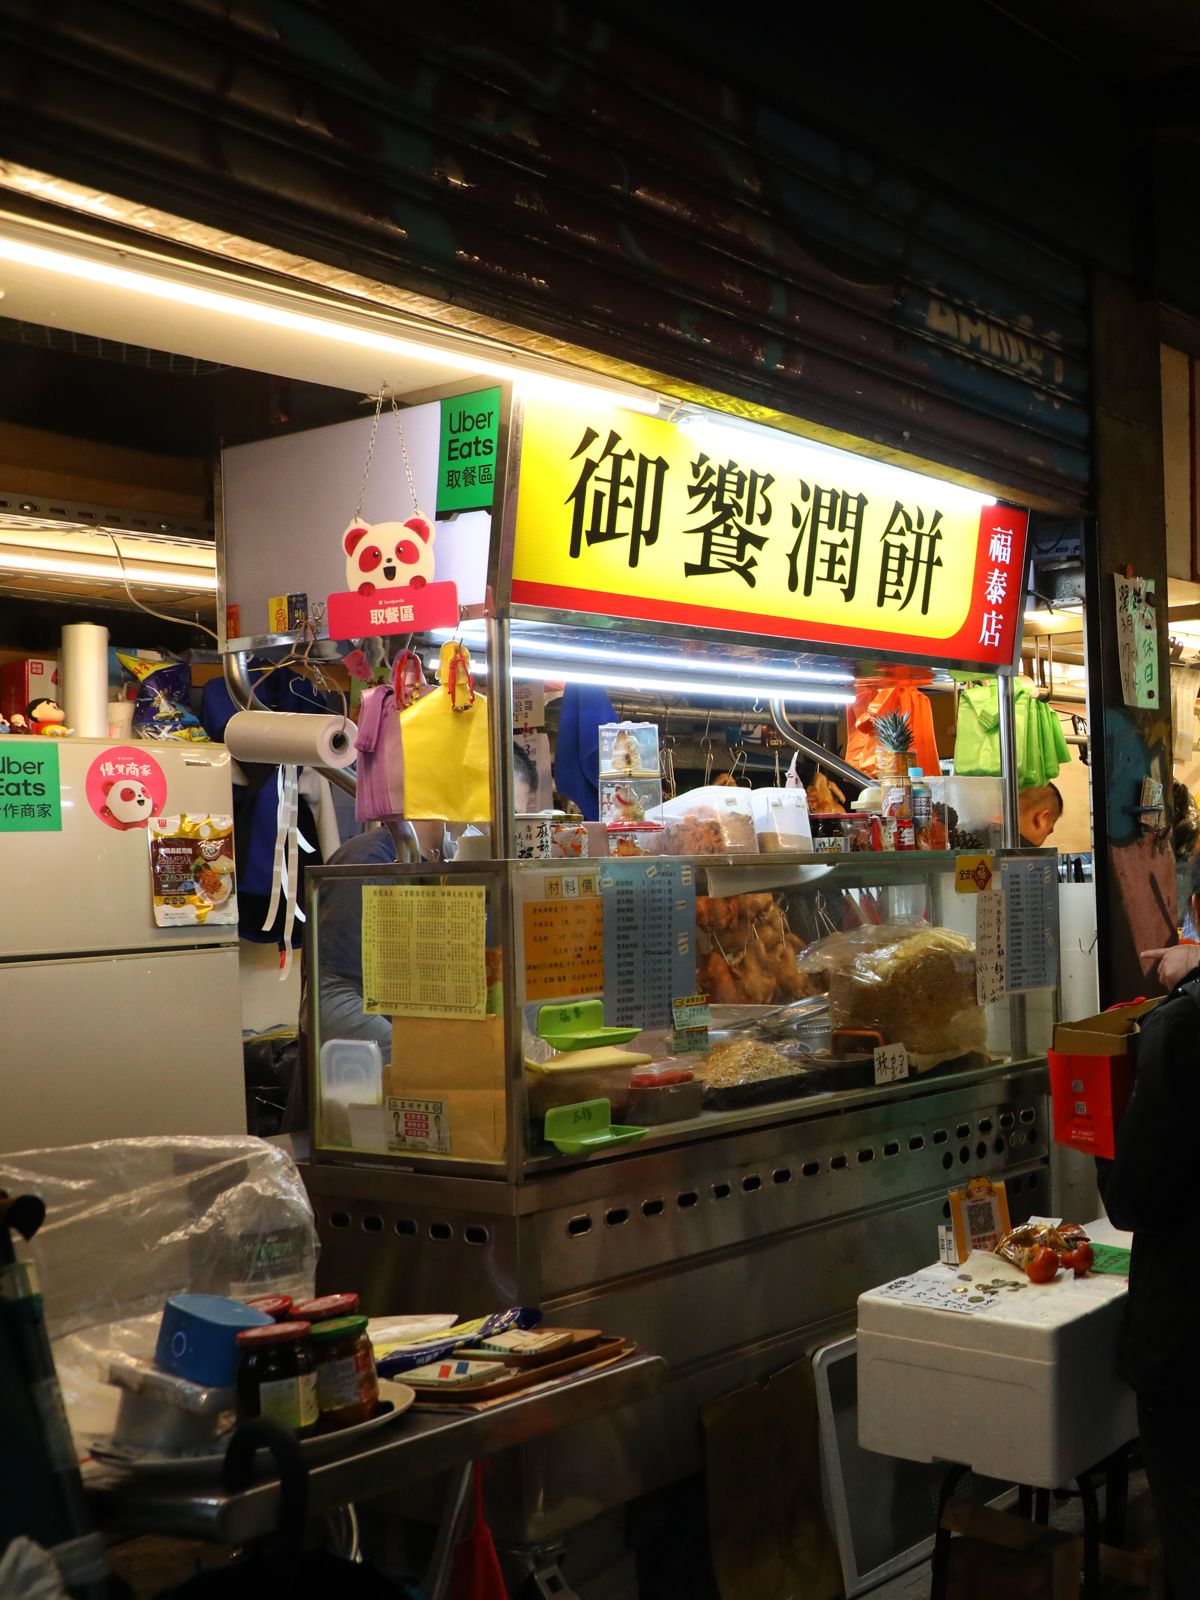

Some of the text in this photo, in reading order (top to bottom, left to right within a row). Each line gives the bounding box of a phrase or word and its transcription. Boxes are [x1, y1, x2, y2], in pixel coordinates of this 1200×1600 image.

[448, 407, 494, 434] Uber
[447, 435, 494, 462] Eats
[446, 464, 494, 488] 取餐區
[564, 426, 943, 615] 御饗潤餅
[978, 527, 1013, 647] 福泰店
[370, 605, 415, 626] 取餐區
[100, 762, 152, 778] 優質商家
[0, 803, 52, 819] 作商家
